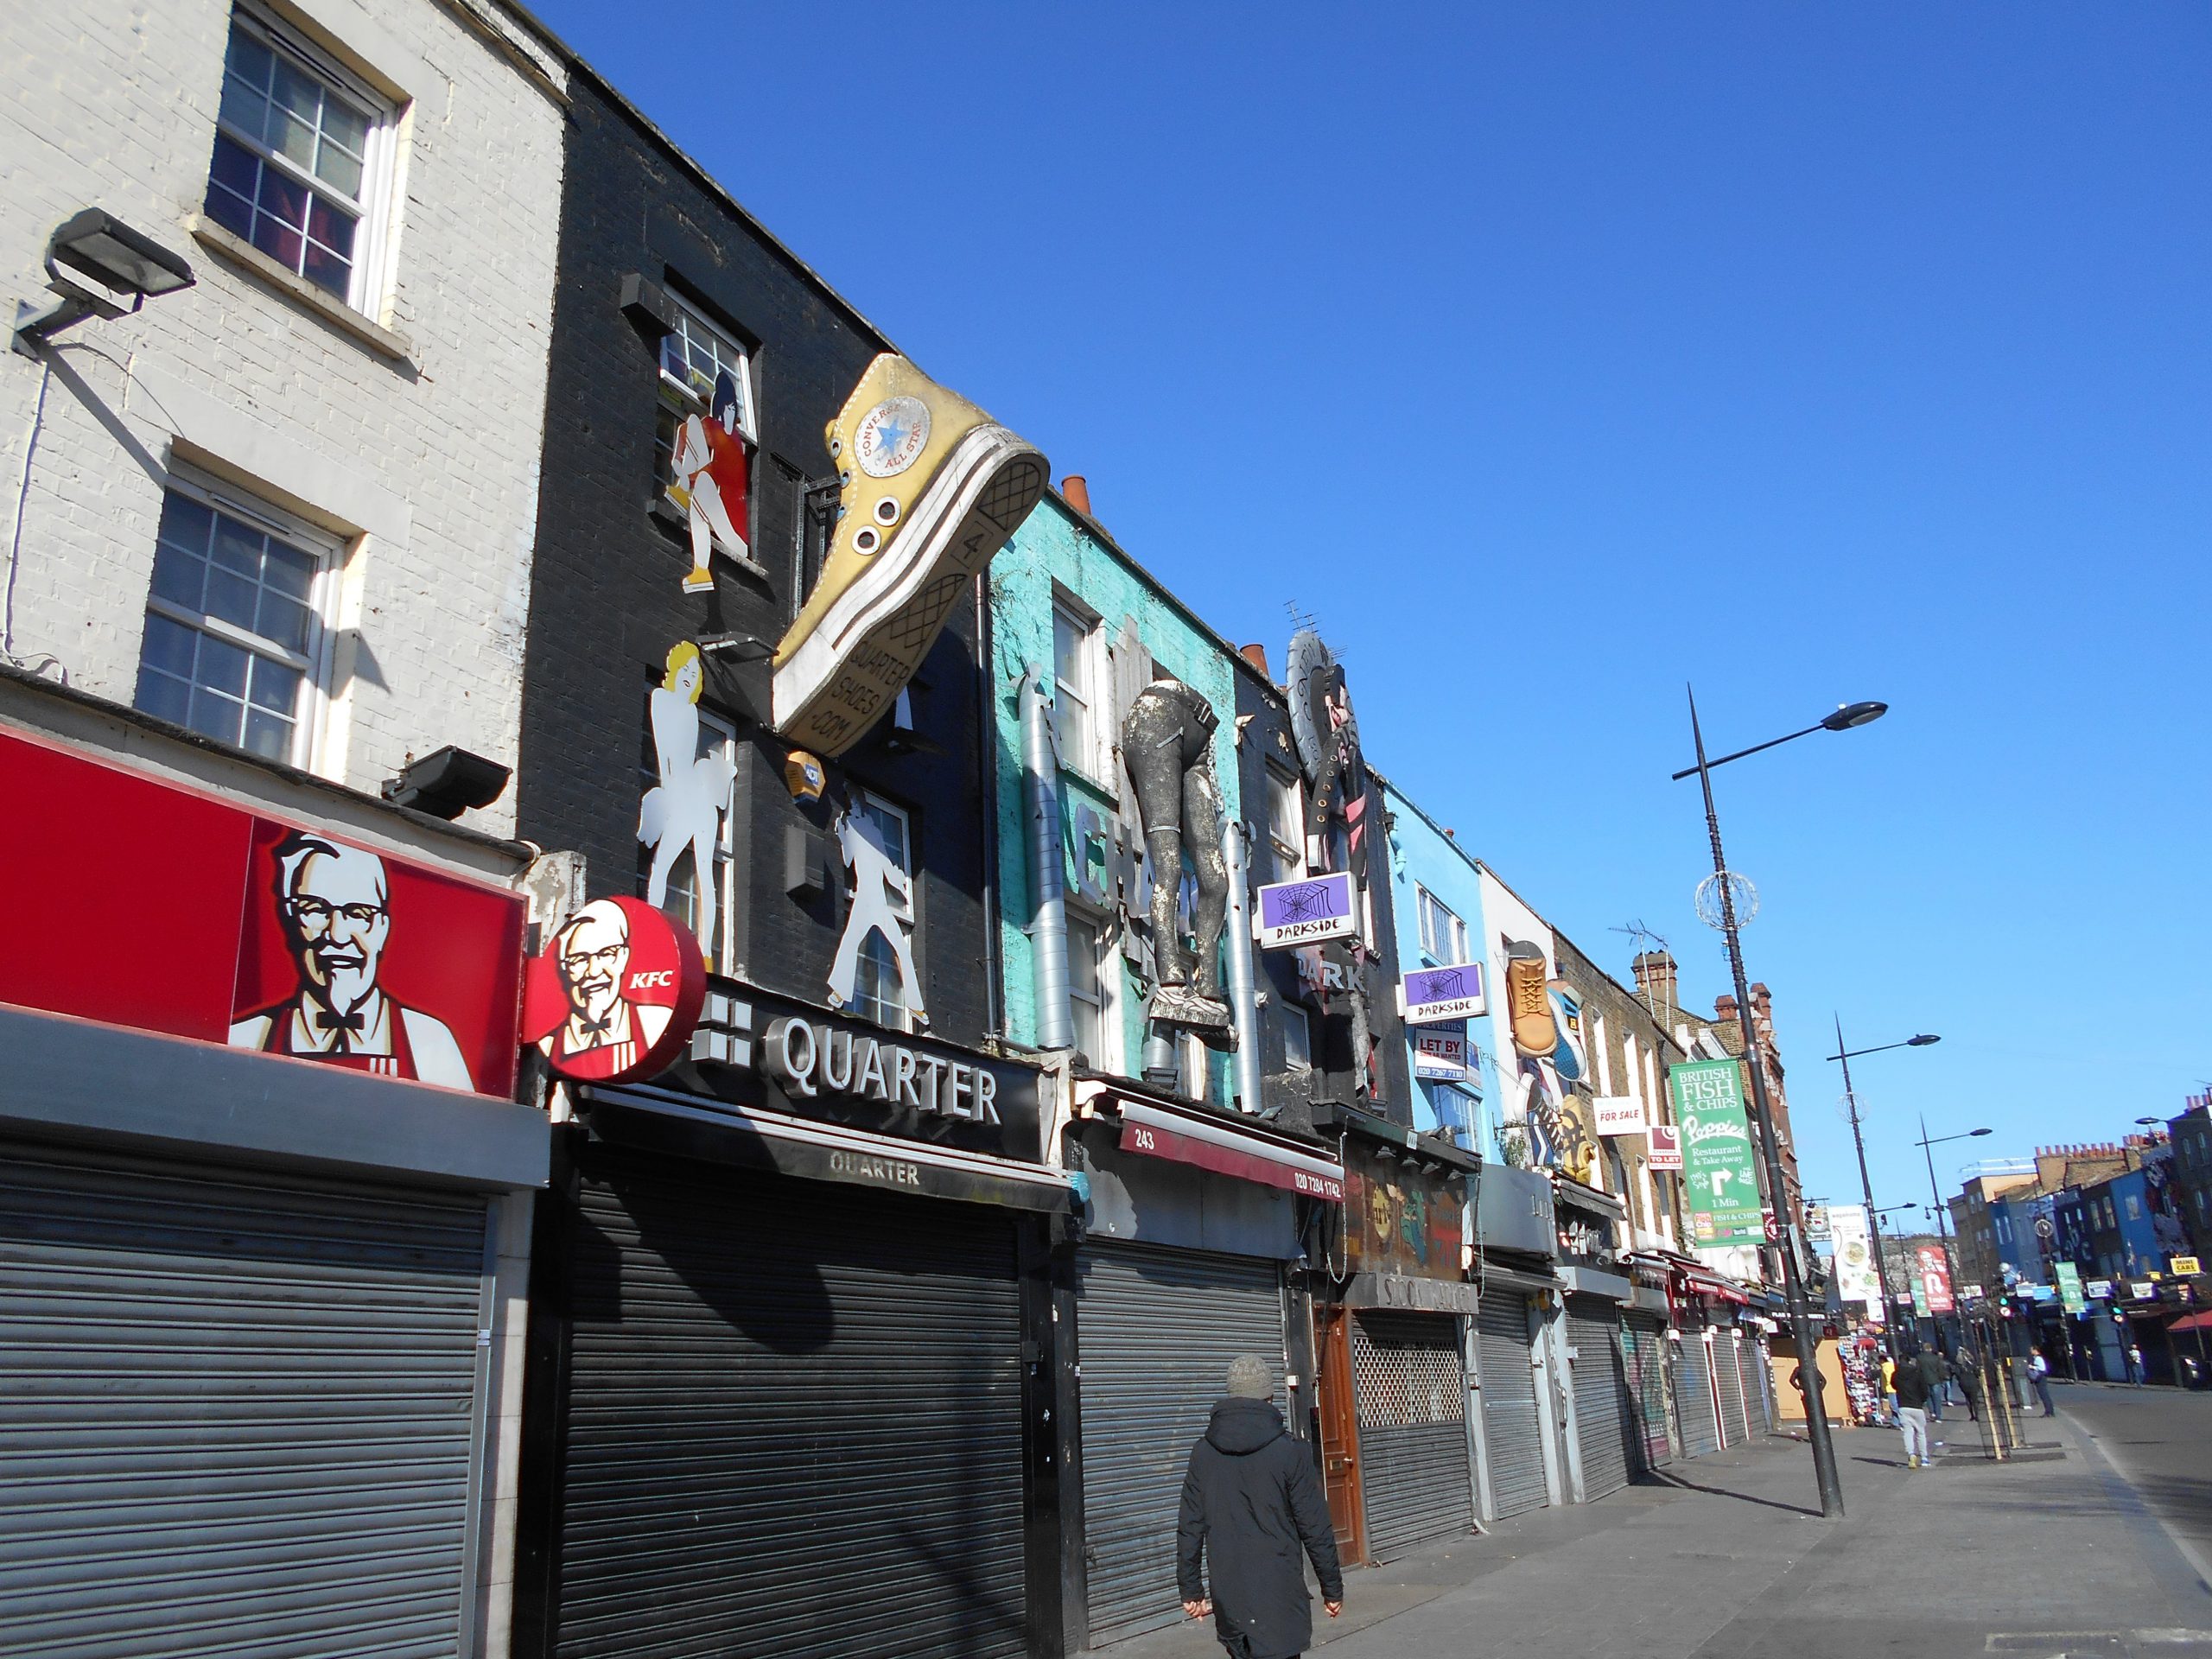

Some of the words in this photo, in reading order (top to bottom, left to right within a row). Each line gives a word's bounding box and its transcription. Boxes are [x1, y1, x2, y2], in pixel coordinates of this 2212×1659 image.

[885, 453, 907, 468] ALL
[906, 422, 922, 452] STAR
[963, 532, 984, 560] 4
[850, 640, 911, 689] QUARTER
[831, 677, 880, 714] SHOES
[1277, 918, 1340, 939] DARKSIDE
[629, 969, 672, 990] KFC
[1419, 1000, 1472, 1016] DARKSIDE
[1420, 1039, 1441, 1052] LET
[1446, 1040, 1460, 1053] BY
[774, 1016, 1001, 1125] QUARTER
[1678, 1067, 1733, 1084] BRITISH
[1680, 1078, 1736, 1102] FISH
[1683, 1102, 1694, 1112] &
[1696, 1096, 1738, 1110] CHIPS
[1600, 1112, 1617, 1122] FOR
[1619, 1109, 1639, 1120] SALE
[1135, 1128, 1154, 1150] 243
[1682, 1115, 1748, 1147] Poppies
[1692, 1145, 1742, 1157] Restaurant
[1702, 1156, 1720, 1165] Take
[1721, 1155, 1744, 1164] Away
[1294, 1172, 1307, 1191] 020
[1309, 1175, 1324, 1195] 7284
[1325, 1180, 1341, 1198] 1742
[1712, 1199, 1717, 1208] 1
[1719, 1198, 1738, 1207] Min
